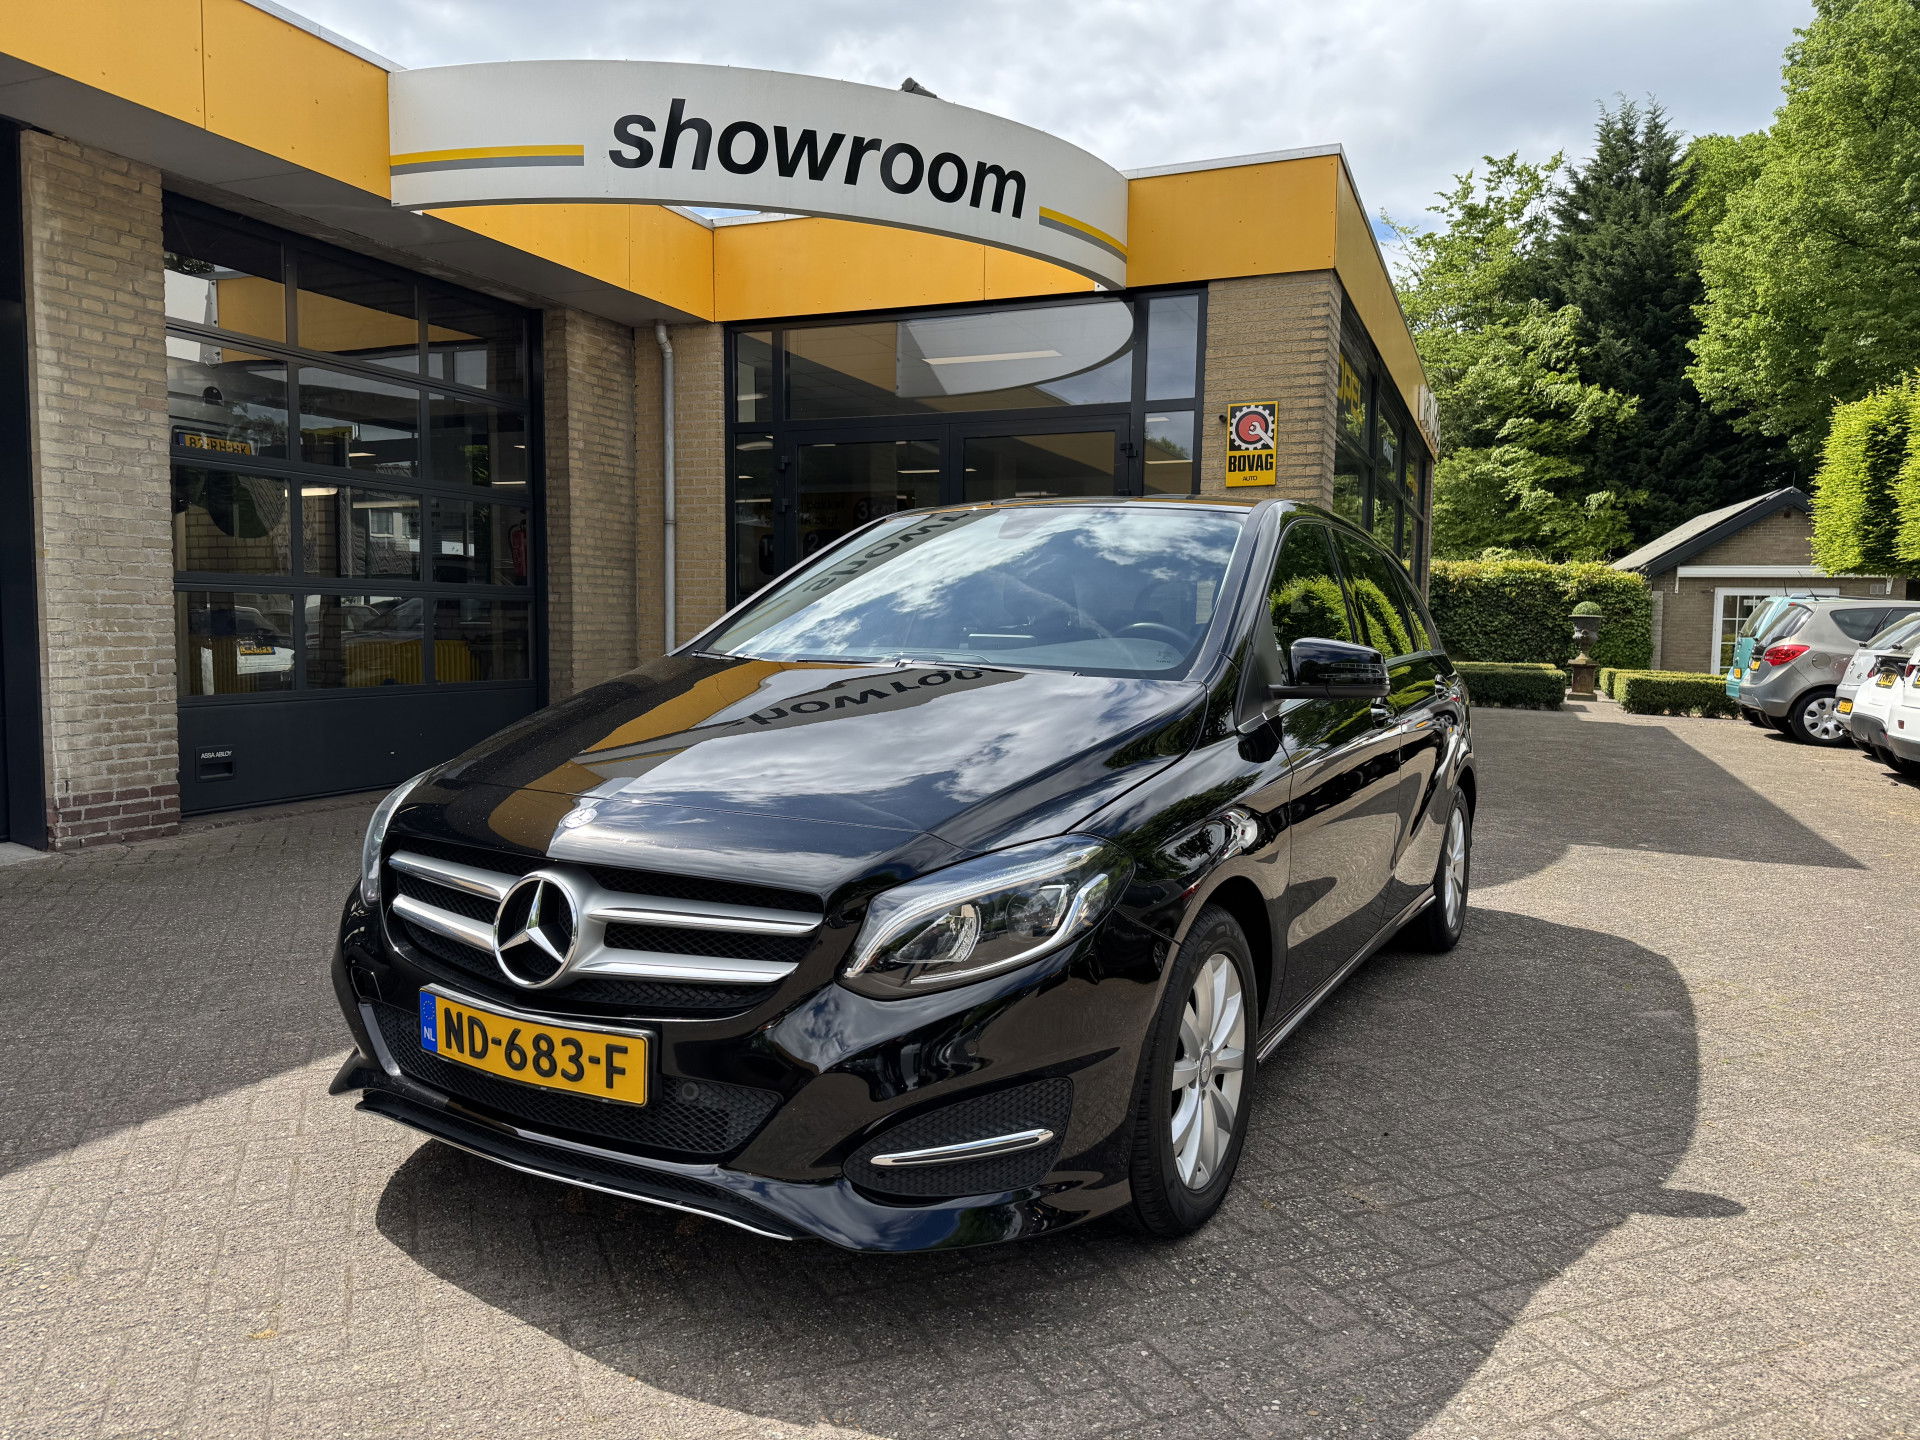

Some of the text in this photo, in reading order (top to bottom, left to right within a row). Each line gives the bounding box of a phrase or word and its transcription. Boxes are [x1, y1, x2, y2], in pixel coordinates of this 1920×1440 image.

[608, 98, 1026, 220] showroom
[1228, 453, 1274, 473] BOVAG
[216, 750, 232, 758] ABLOY
[423, 1007, 629, 1089] NL ND-683-F
